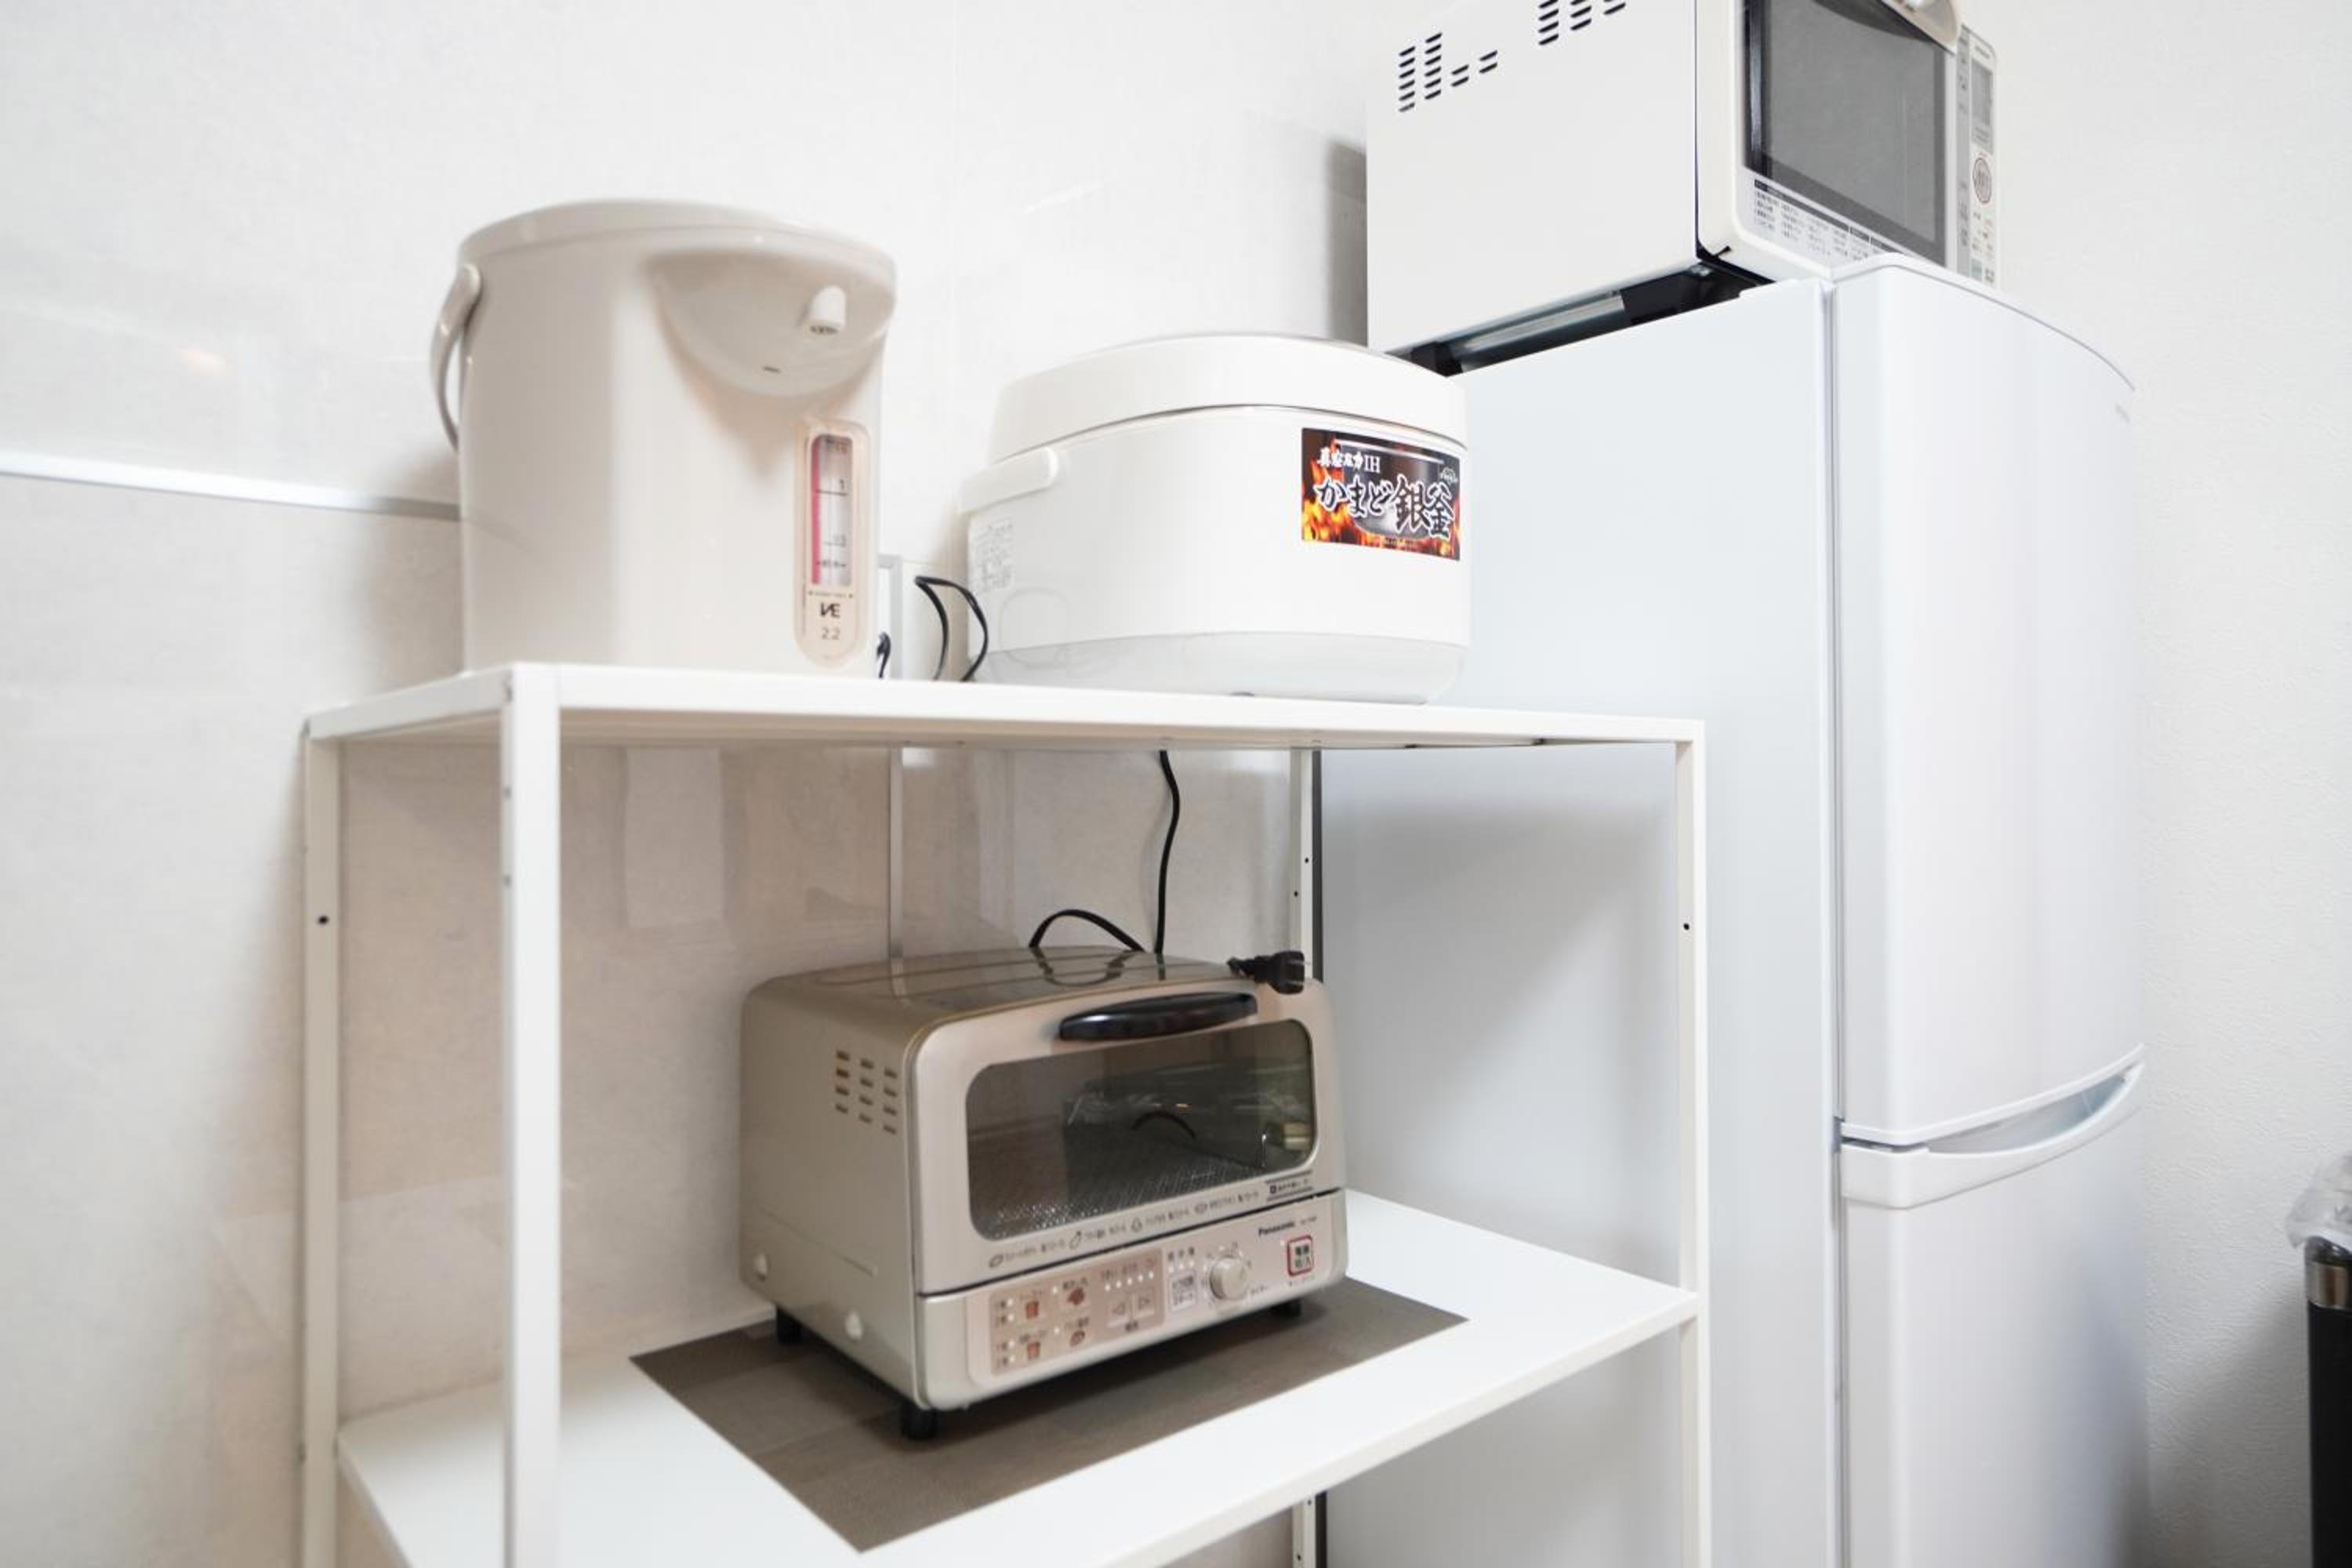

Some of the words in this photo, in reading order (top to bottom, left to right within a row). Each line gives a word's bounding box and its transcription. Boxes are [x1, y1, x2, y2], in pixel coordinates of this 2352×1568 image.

[1313, 474, 1454, 541] かまど銀釜
[1258, 1221, 1295, 1236] Panasonic
